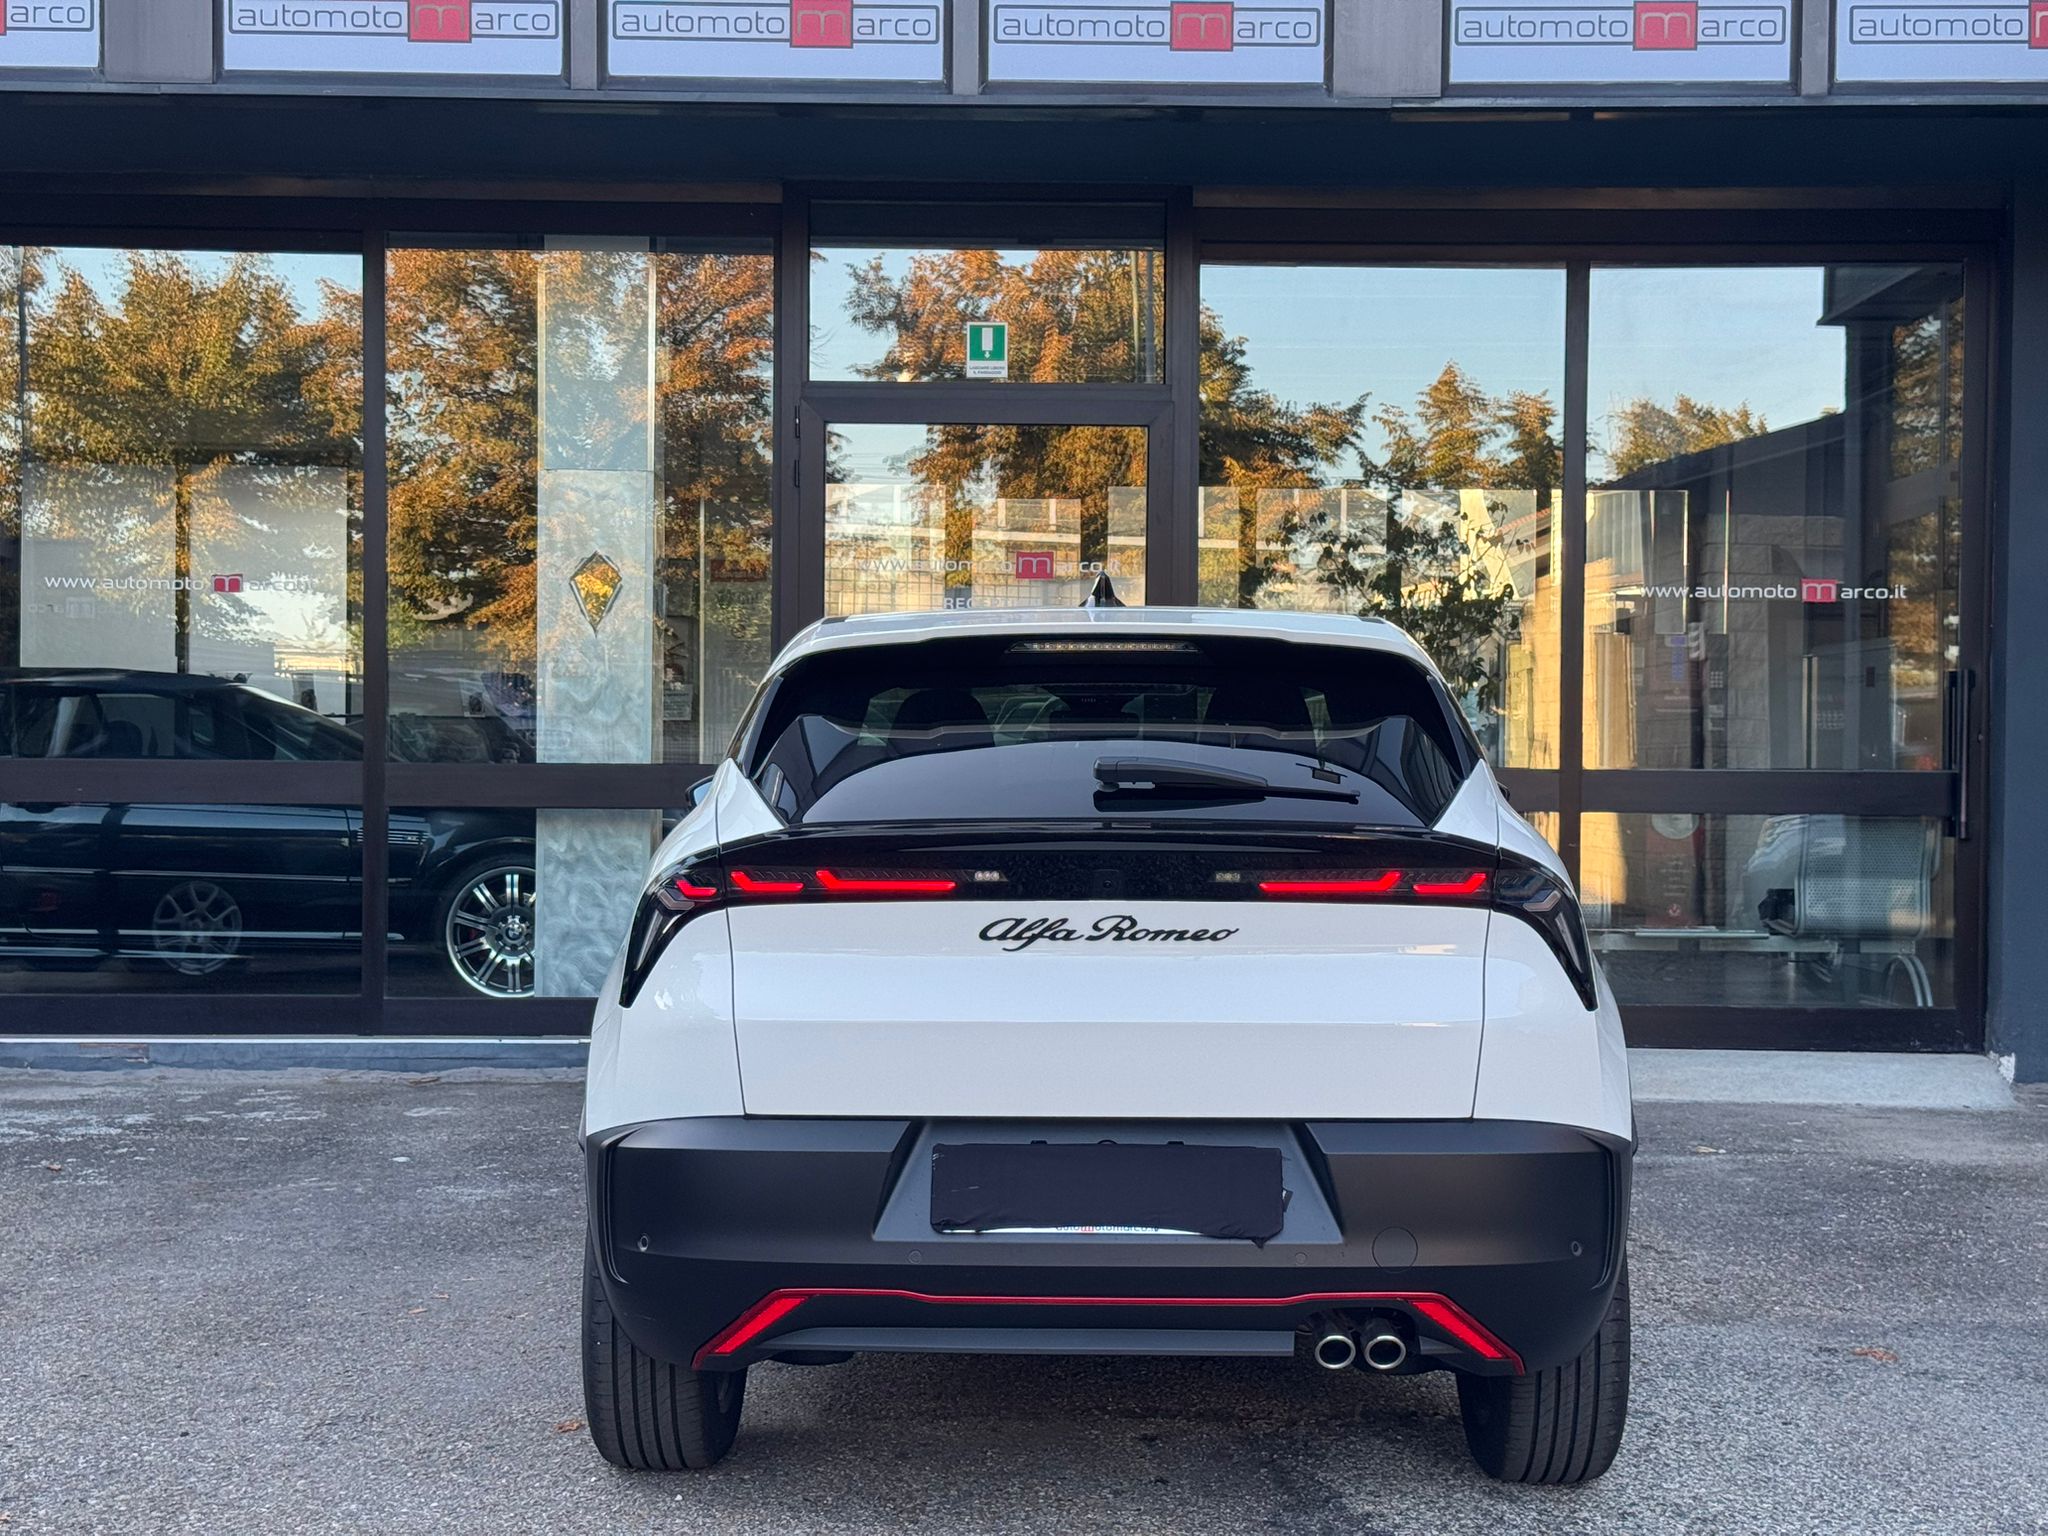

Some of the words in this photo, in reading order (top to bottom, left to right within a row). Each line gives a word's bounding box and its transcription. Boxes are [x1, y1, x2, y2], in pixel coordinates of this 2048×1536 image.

[9, 5, 86, 24] arco
[978, 916, 1084, 952] Alfa
[1085, 914, 1239, 942] Romeo
